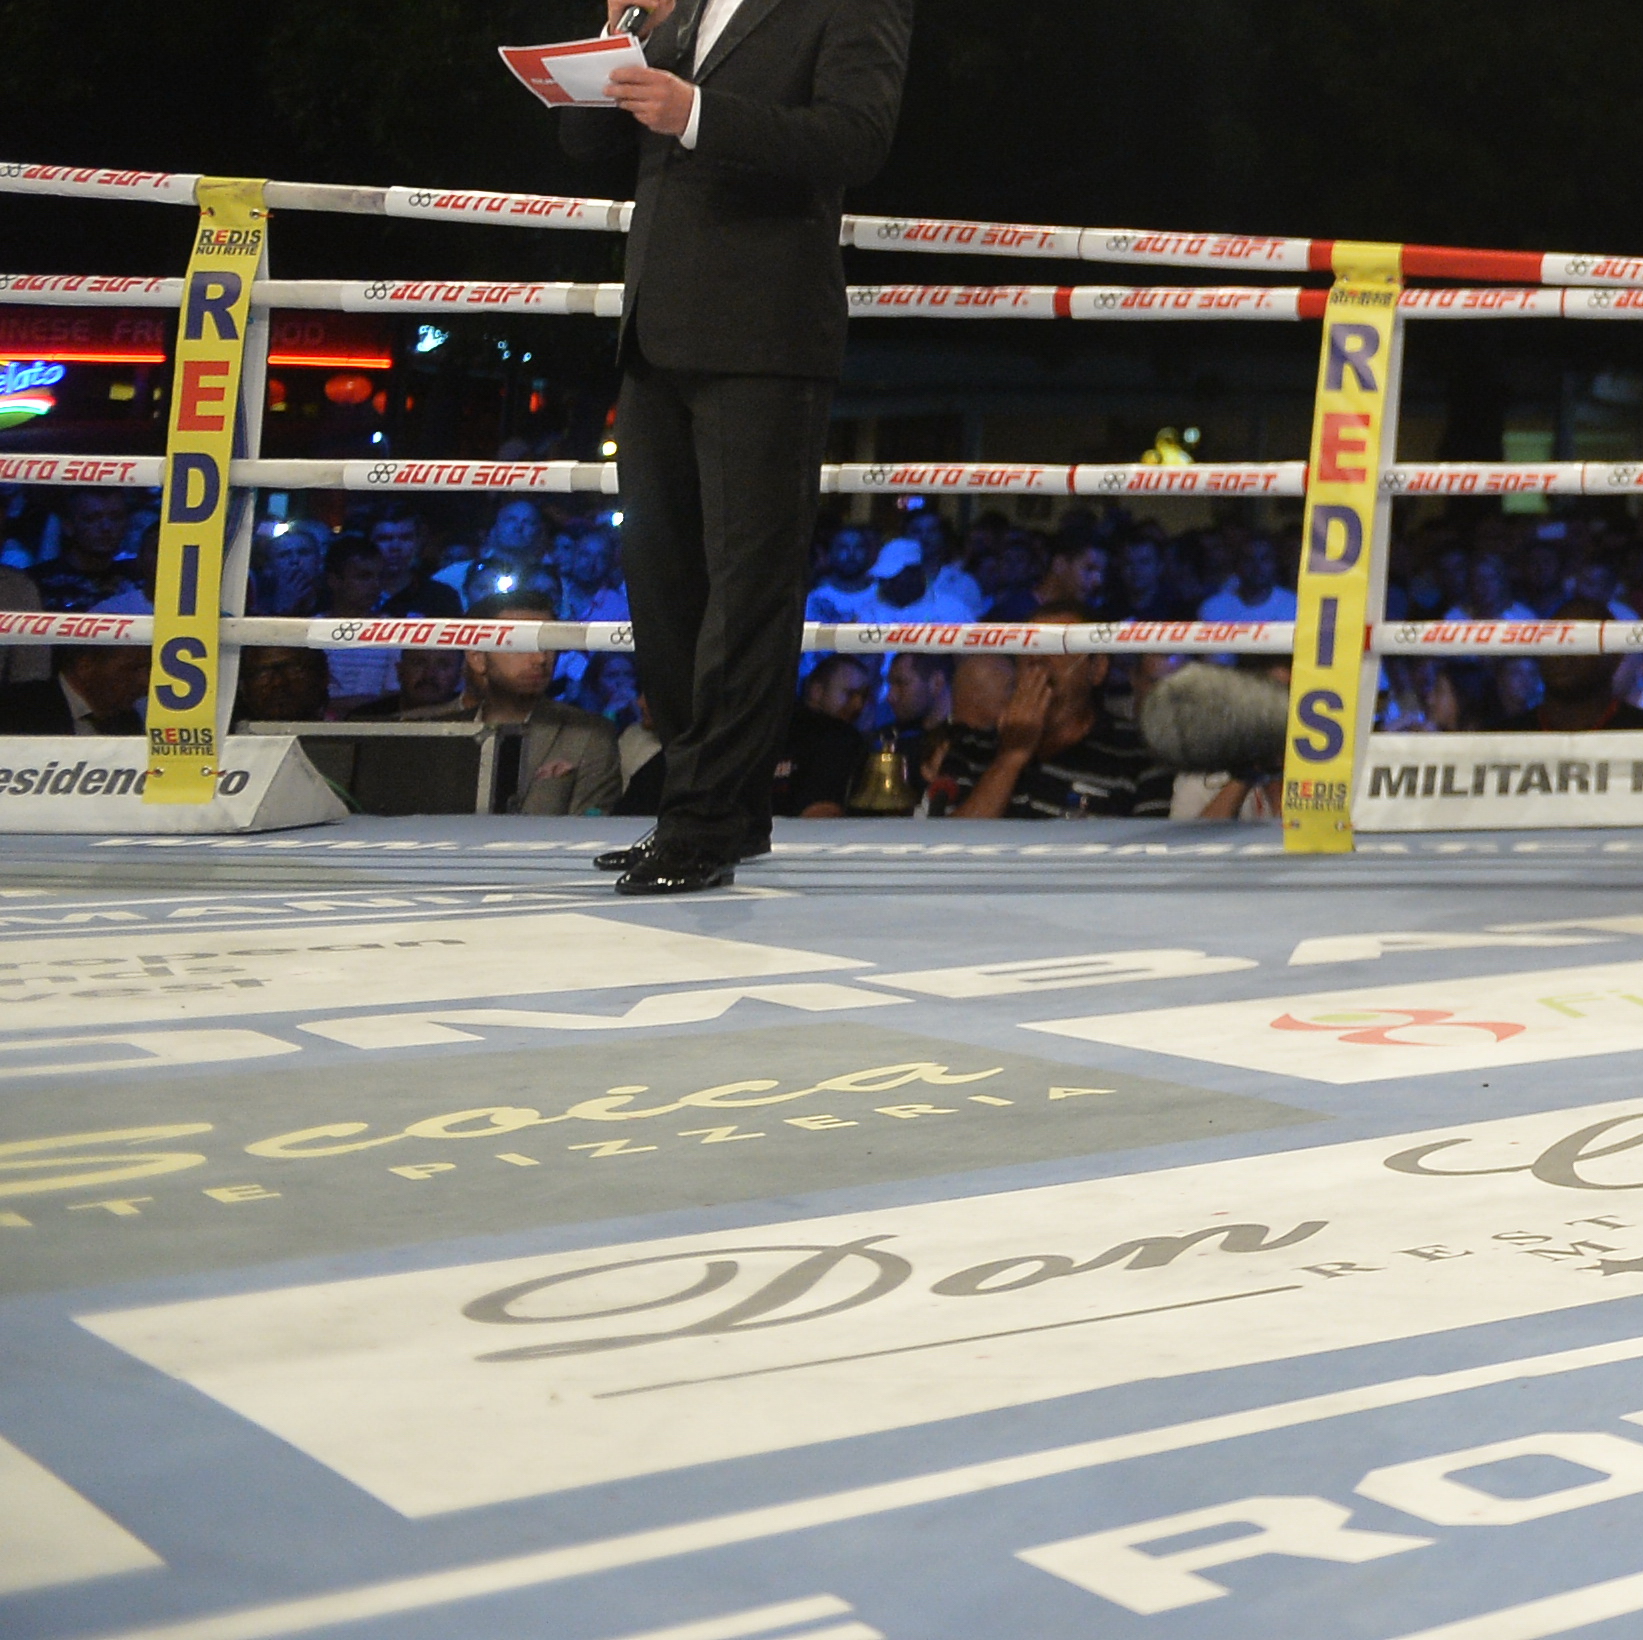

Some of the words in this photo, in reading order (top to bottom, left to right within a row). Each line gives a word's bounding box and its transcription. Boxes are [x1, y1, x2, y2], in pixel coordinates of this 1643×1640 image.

[195, 244, 259, 256] NUTRITIE
[200, 229, 262, 245] REDIS
[155, 271, 243, 712] REDIS
[1293, 322, 1380, 761] REDIS
[150, 728, 214, 744] REDIS
[150, 744, 215, 756] NUTRITIE
[1368, 759, 1610, 798] MILITARI
[388, 1087, 1117, 1182] PIZZERIA
[460, 1221, 1330, 1361] Don
